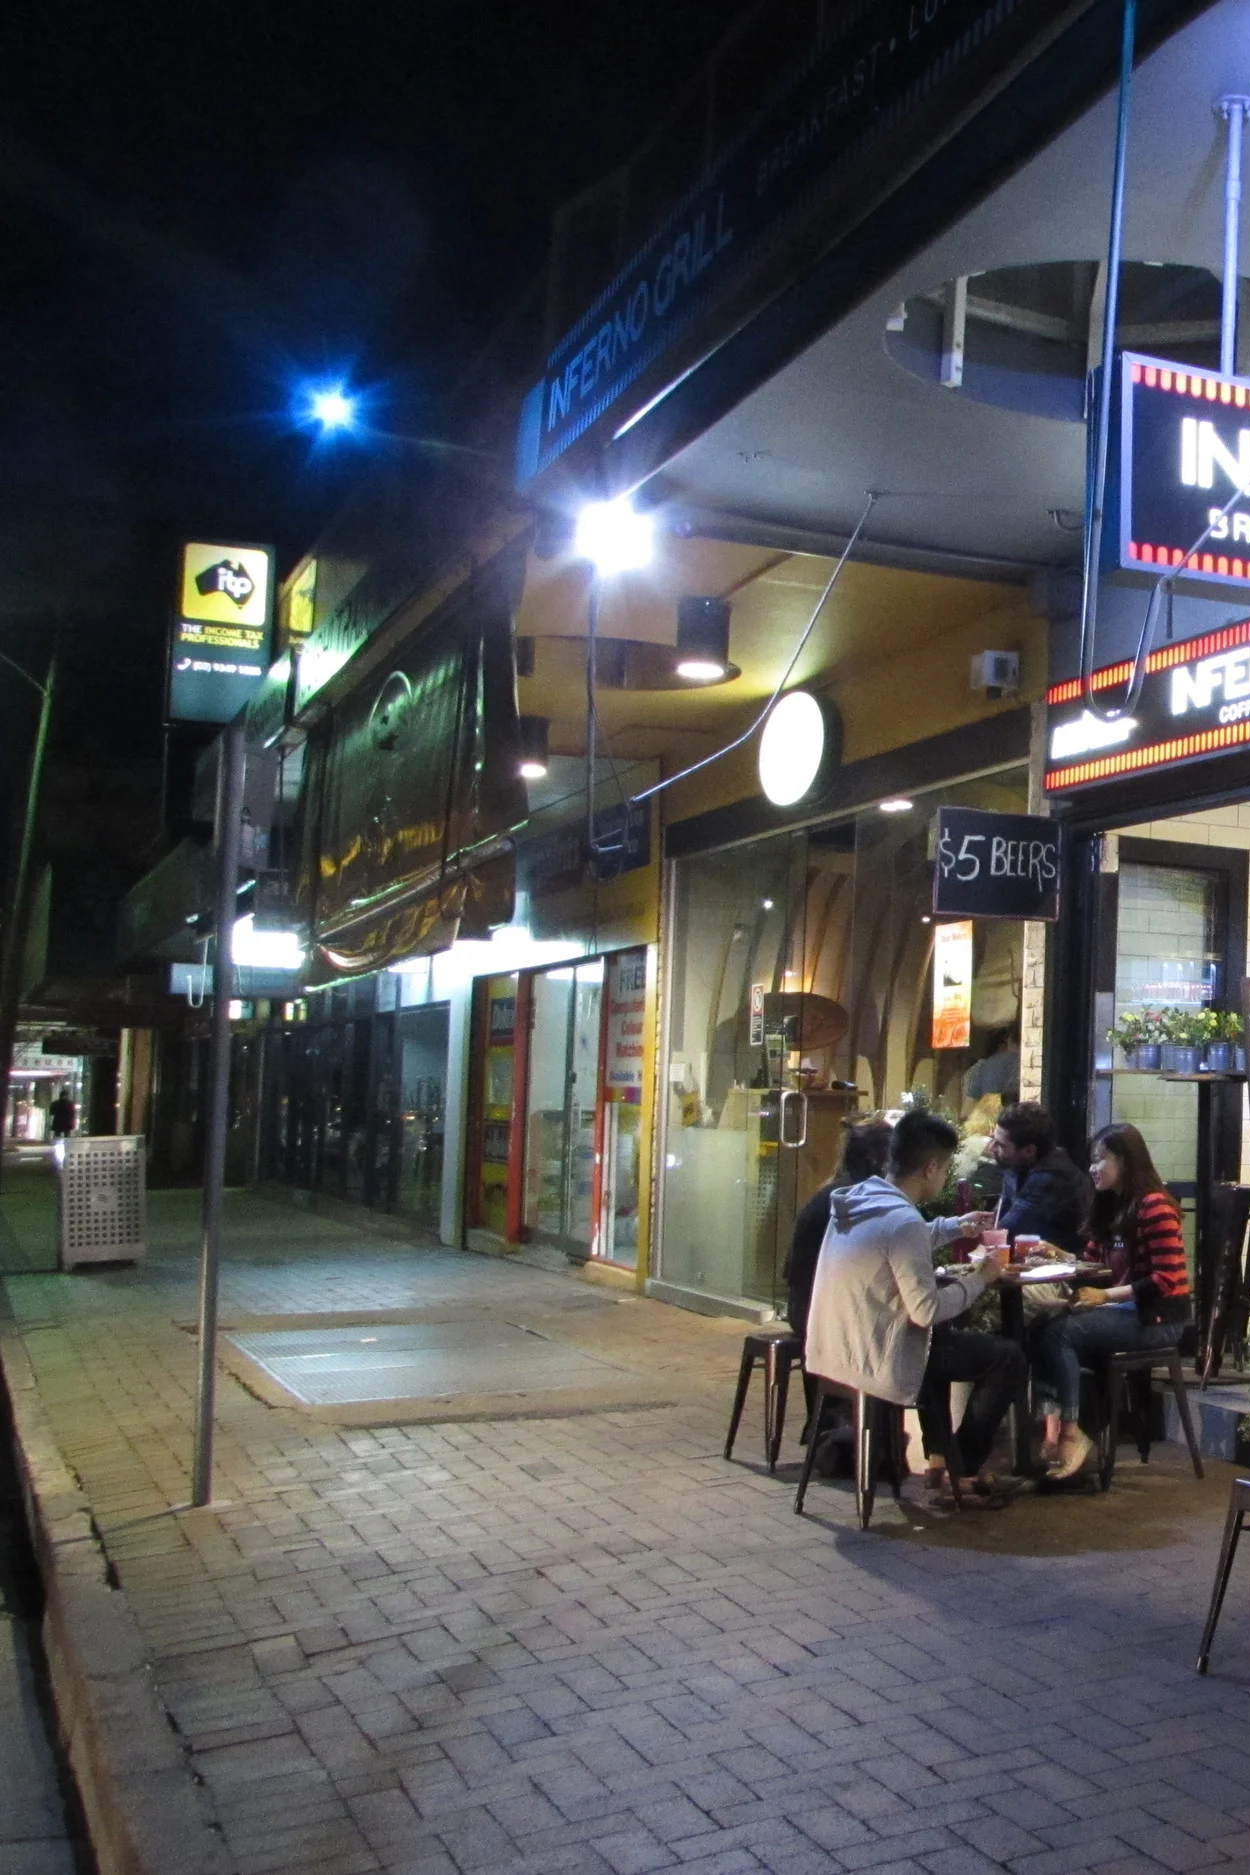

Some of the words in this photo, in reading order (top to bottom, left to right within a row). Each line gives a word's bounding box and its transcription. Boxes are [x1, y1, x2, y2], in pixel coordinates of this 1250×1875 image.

[548, 279, 649, 432] INFERNO
[653, 191, 734, 316] GRILL
[179, 632, 260, 649] PROFESSIONALS
[181, 623, 203, 634] THE
[203, 625, 243, 637] INCOME
[244, 630, 264, 640] TAX
[990, 836, 1057, 893] BEERS
